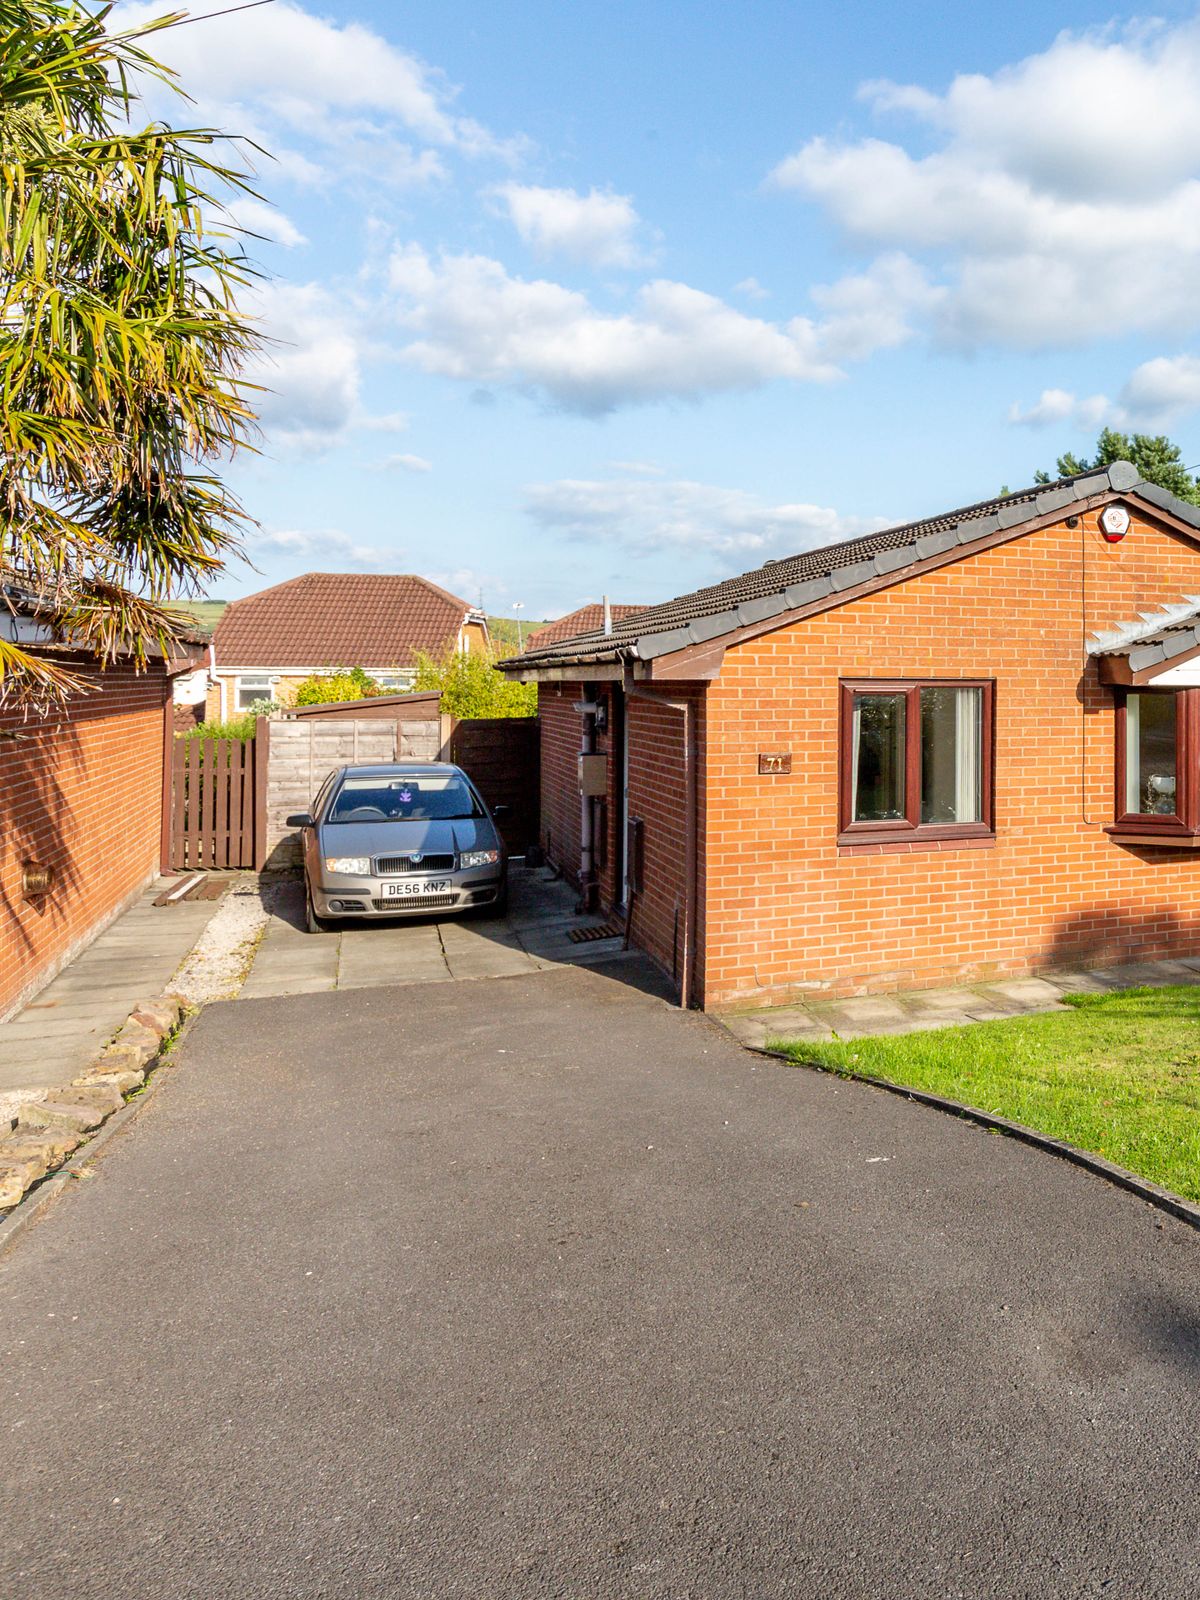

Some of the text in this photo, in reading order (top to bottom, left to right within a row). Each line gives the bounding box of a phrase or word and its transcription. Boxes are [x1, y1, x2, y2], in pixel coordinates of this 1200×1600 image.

[766, 757, 783, 771] 71
[388, 881, 446, 895] DE56 KNZ
